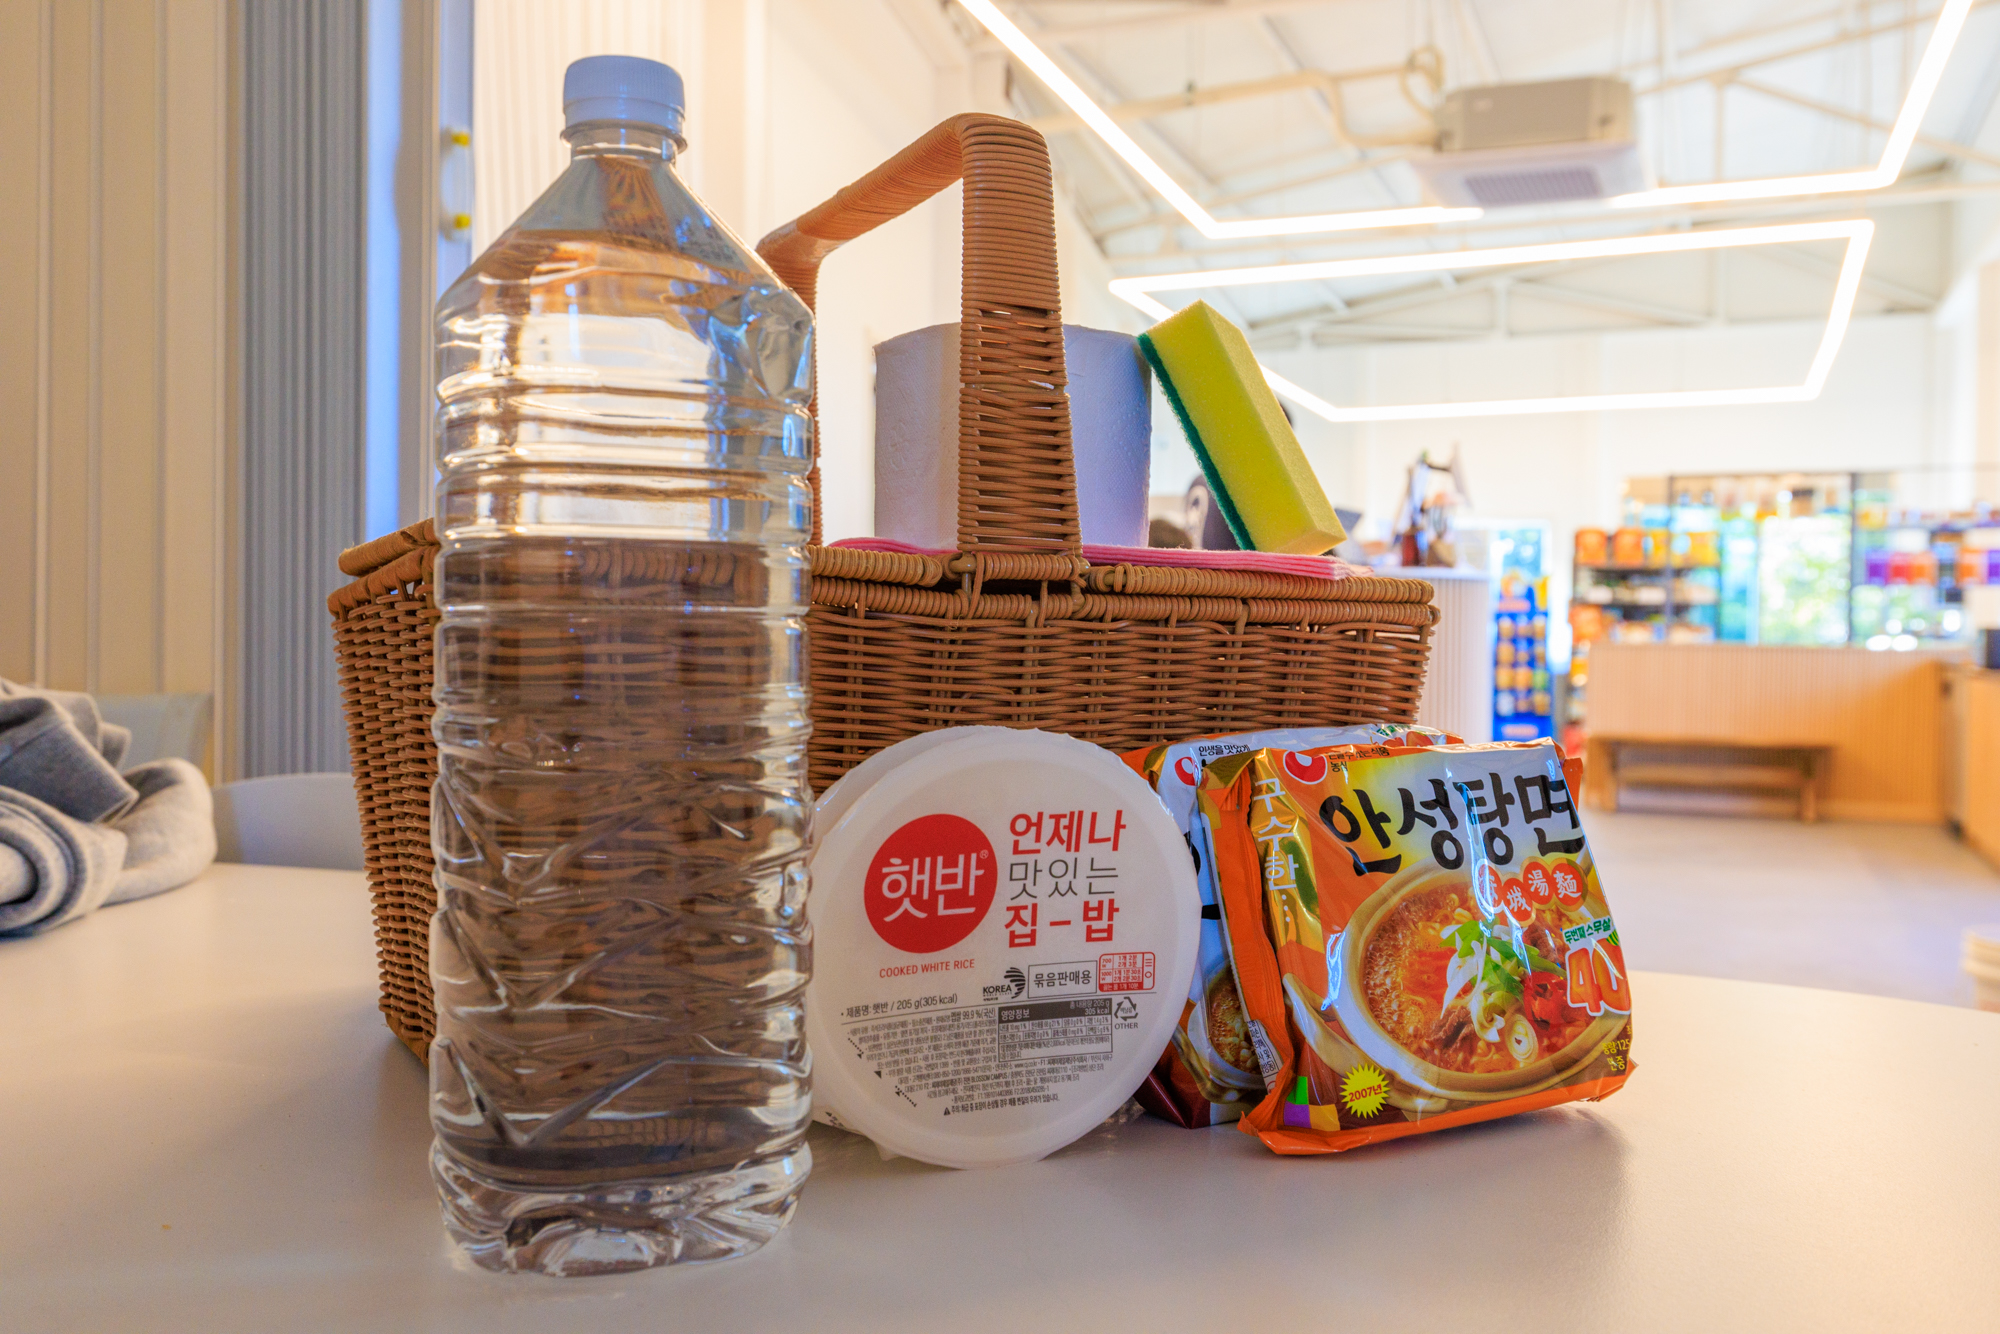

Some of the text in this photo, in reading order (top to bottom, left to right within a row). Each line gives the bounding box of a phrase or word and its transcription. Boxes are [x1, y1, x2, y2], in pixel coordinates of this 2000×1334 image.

[1199, 744, 1224, 757] 인생을
[1009, 810, 1127, 855] 언제나
[1319, 772, 1586, 877] 안성탕면
[1009, 857, 1119, 900] 맛있는
[879, 959, 975, 979] COOKED WHITE RICE
[1567, 936, 1631, 1016] 40
[1033, 970, 1092, 988] 묶음판매용
[982, 985, 1012, 994] KOREA
[846, 1005, 872, 1018] 제품명:
[872, 1002, 888, 1014] 햇반
[896, 999, 912, 1010] 205
[962, 1009, 975, 1020] 99.9
[1000, 1008, 1030, 1021] 영양정보
[1096, 1007, 1110, 1015] kcal
[1114, 1022, 1139, 1030] OTHER
[1348, 1083, 1383, 1102] 2007년
